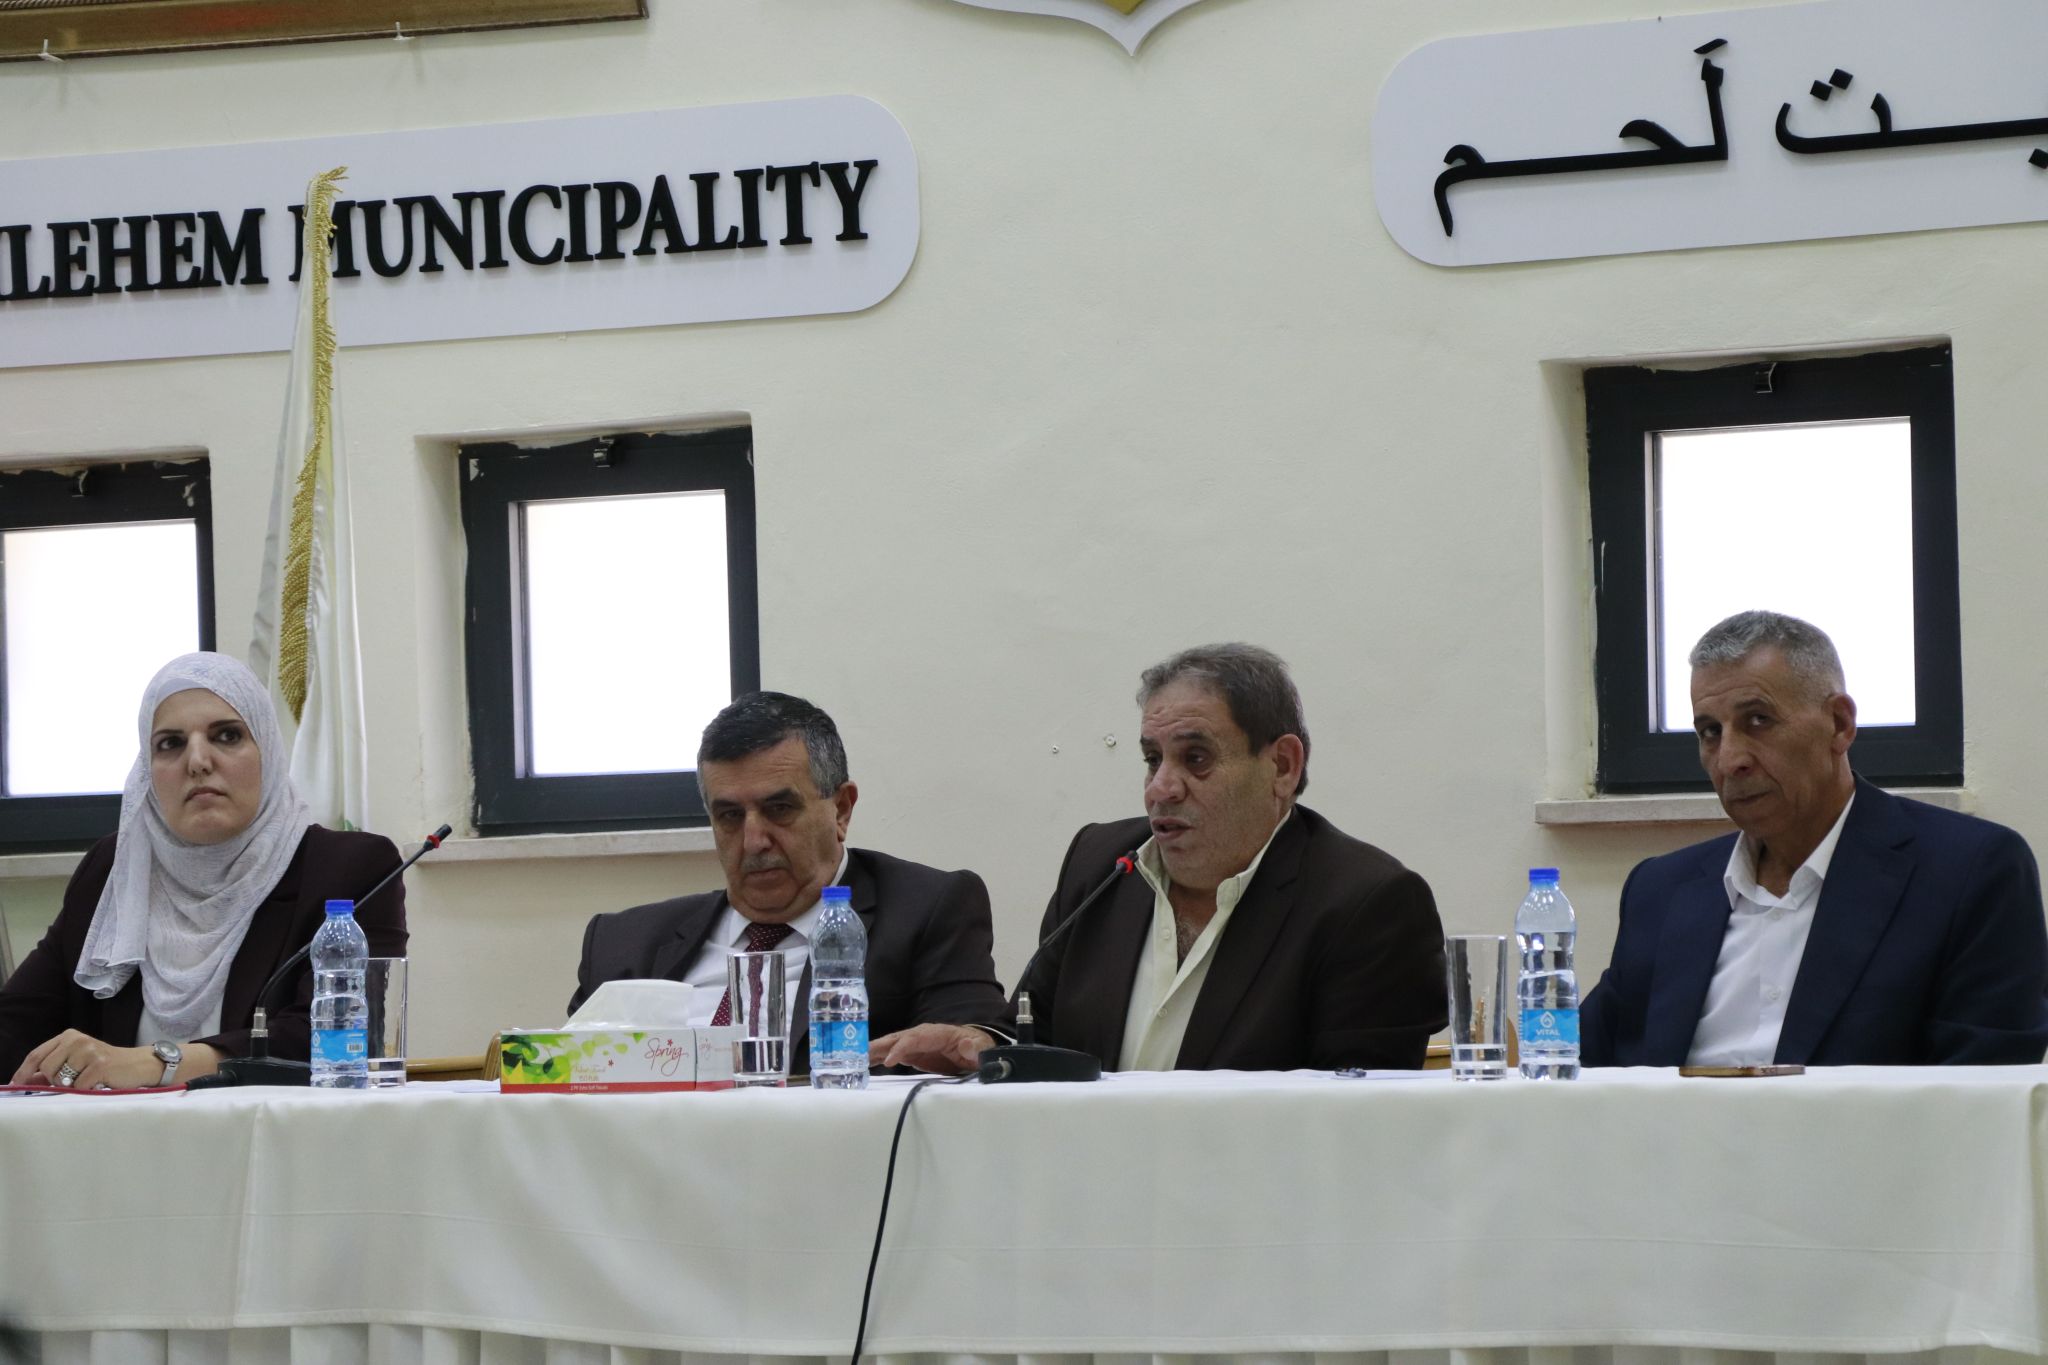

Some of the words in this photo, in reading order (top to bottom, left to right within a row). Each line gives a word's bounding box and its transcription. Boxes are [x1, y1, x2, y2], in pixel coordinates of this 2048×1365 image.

[0, 207, 269, 302] LEHEM
[287, 159, 879, 282] MUNICIPALITY
[644, 1037, 690, 1077] Spring
